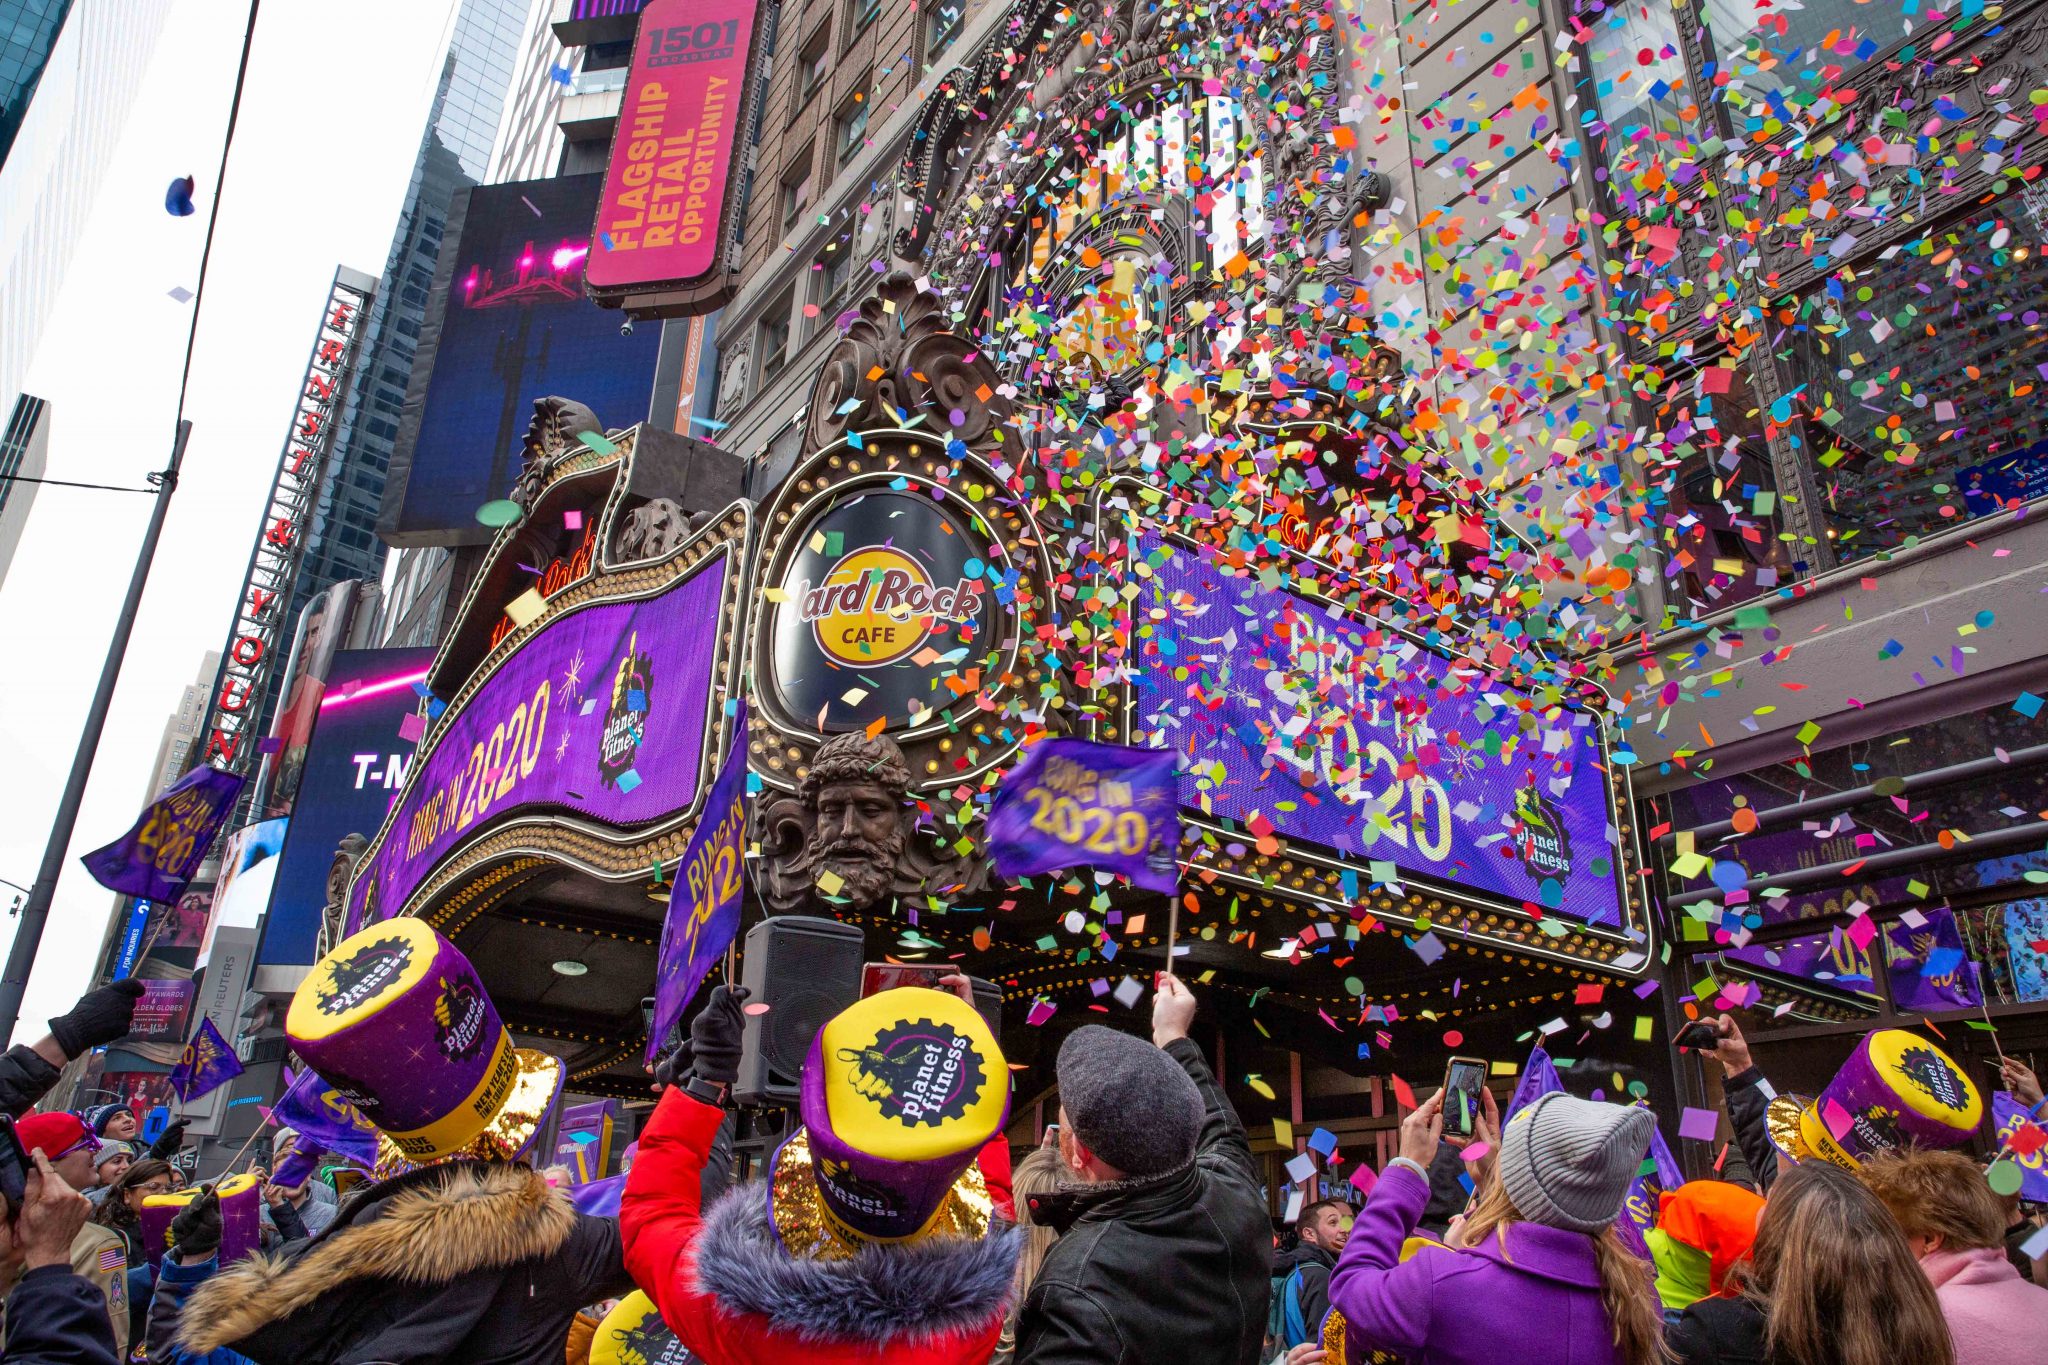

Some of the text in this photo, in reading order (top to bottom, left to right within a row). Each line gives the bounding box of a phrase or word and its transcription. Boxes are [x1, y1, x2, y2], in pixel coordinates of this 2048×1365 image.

[647, 19, 738, 54] 1501
[649, 49, 732, 67] BROADWAY
[610, 81, 669, 252] FLAGSHIP
[643, 128, 695, 248] RETAIL
[679, 76, 728, 245] OPPORTUNITY
[686, 319, 701, 385] THOMSON
[205, 303, 352, 764] ERNST & YOUN
[874, 569, 982, 634] Rock
[841, 627, 896, 644] CAFE
[602, 709, 638, 750] planet
[406, 679, 550, 862] RING IN 2020
[1024, 786, 1148, 856] 2020
[214, 955, 235, 1008] REUTERS
[329, 955, 393, 1011] planet
[344, 948, 410, 1008] fitness
[156, 1004, 184, 1012] GLOBES
[443, 995, 478, 1052] planet
[456, 997, 486, 1054] fitness
[473, 1085, 493, 1113] NEW
[903, 1043, 943, 1119] planet
[922, 1037, 967, 1113] fitness
[1924, 1063, 1953, 1107] planet
[1935, 1058, 1959, 1107] fitness
[479, 1099, 496, 1120] TIMES
[1854, 1114, 1896, 1151] planet
[1854, 1124, 1885, 1151] fitne
[1820, 1137, 1836, 1155] NEW
